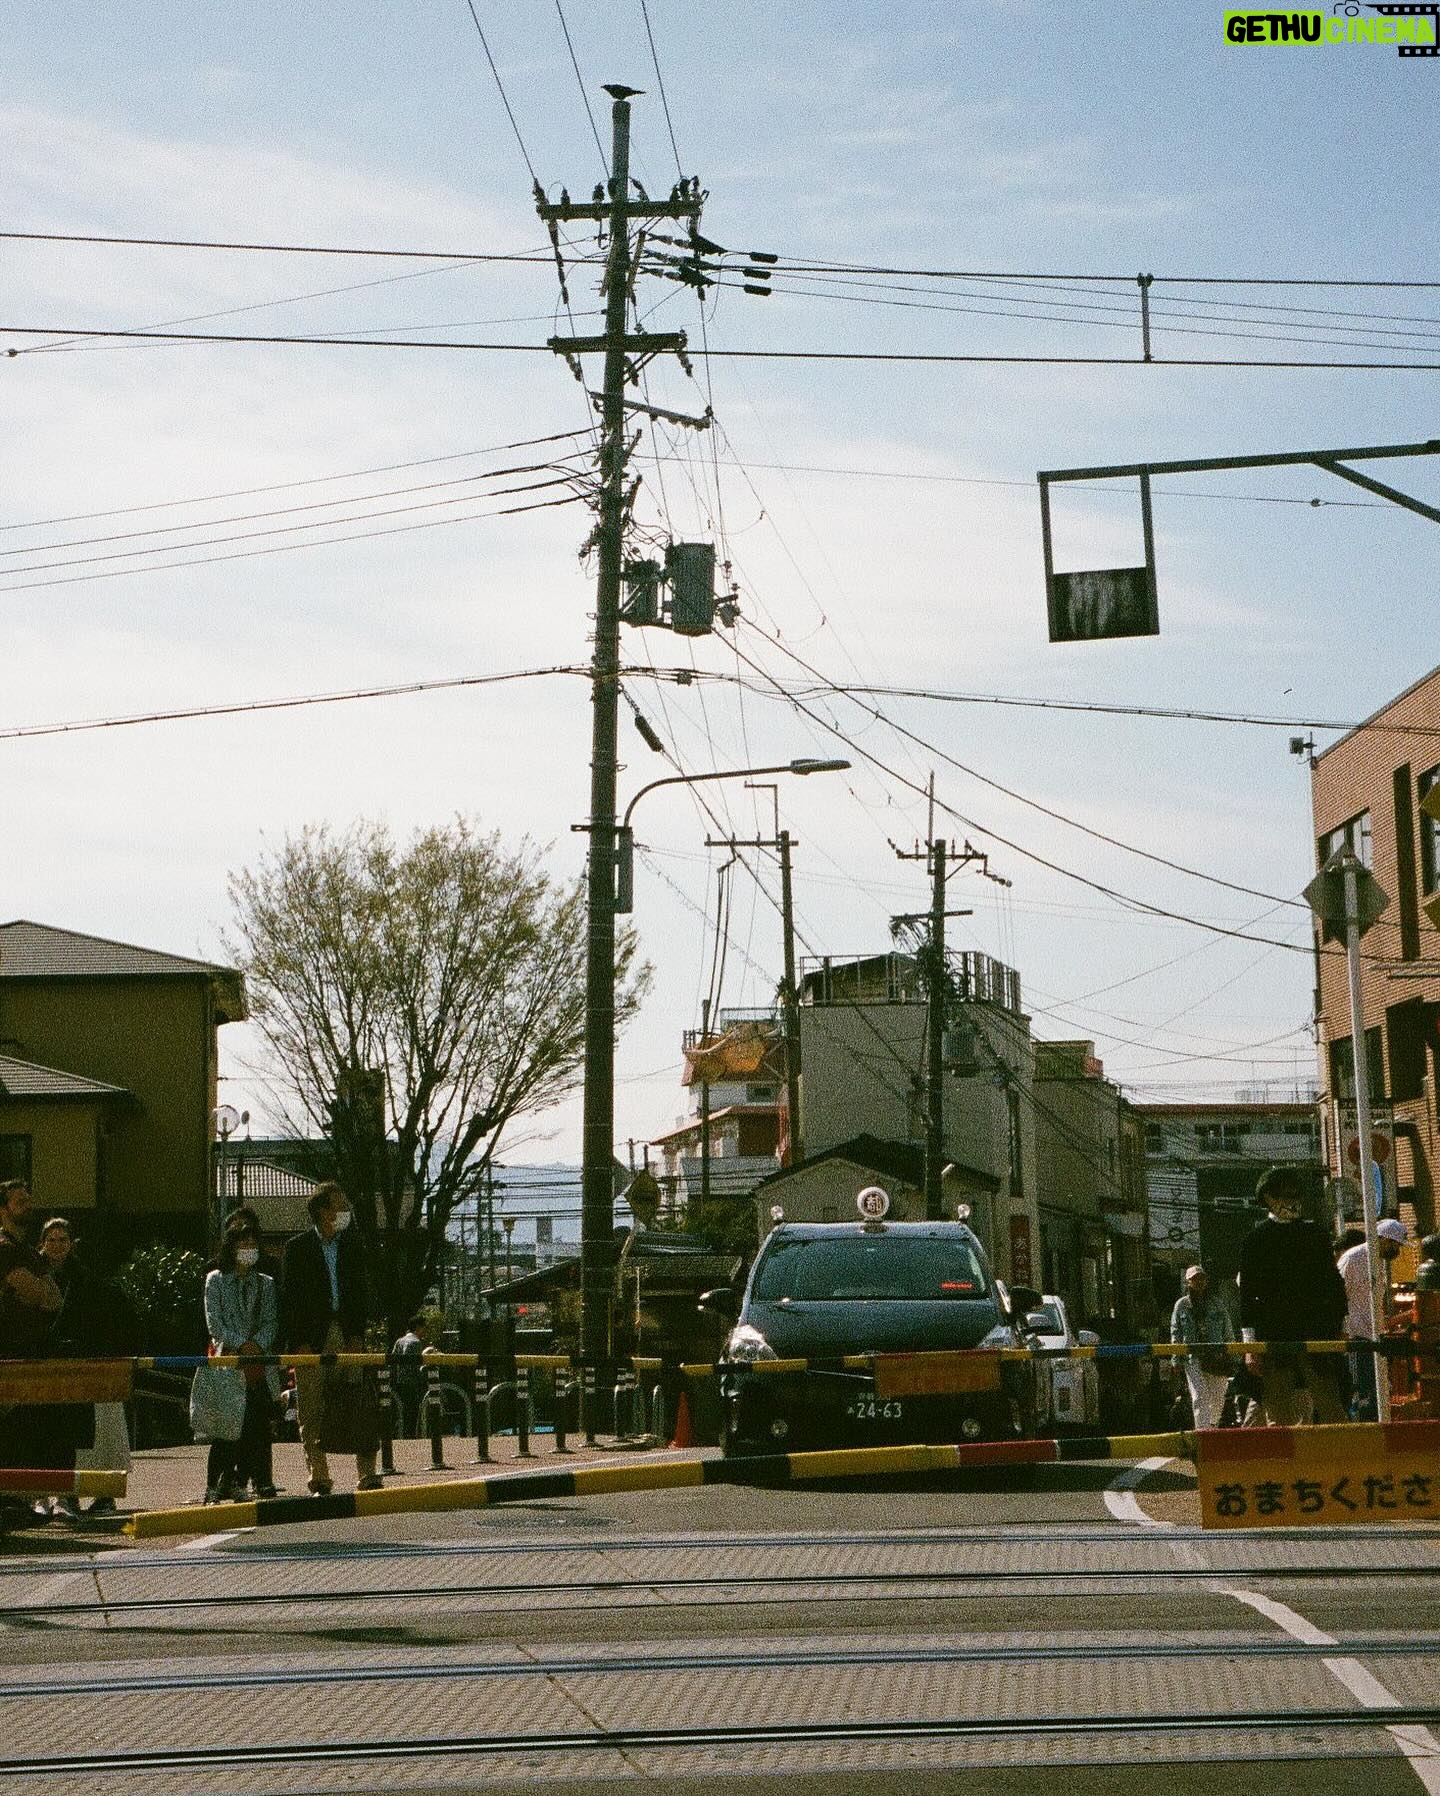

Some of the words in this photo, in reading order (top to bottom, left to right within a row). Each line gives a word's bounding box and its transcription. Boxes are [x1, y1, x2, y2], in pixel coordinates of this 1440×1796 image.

[856, 1402, 902, 1419] 24-63
[1214, 1472, 1433, 1517] おまちくださ
